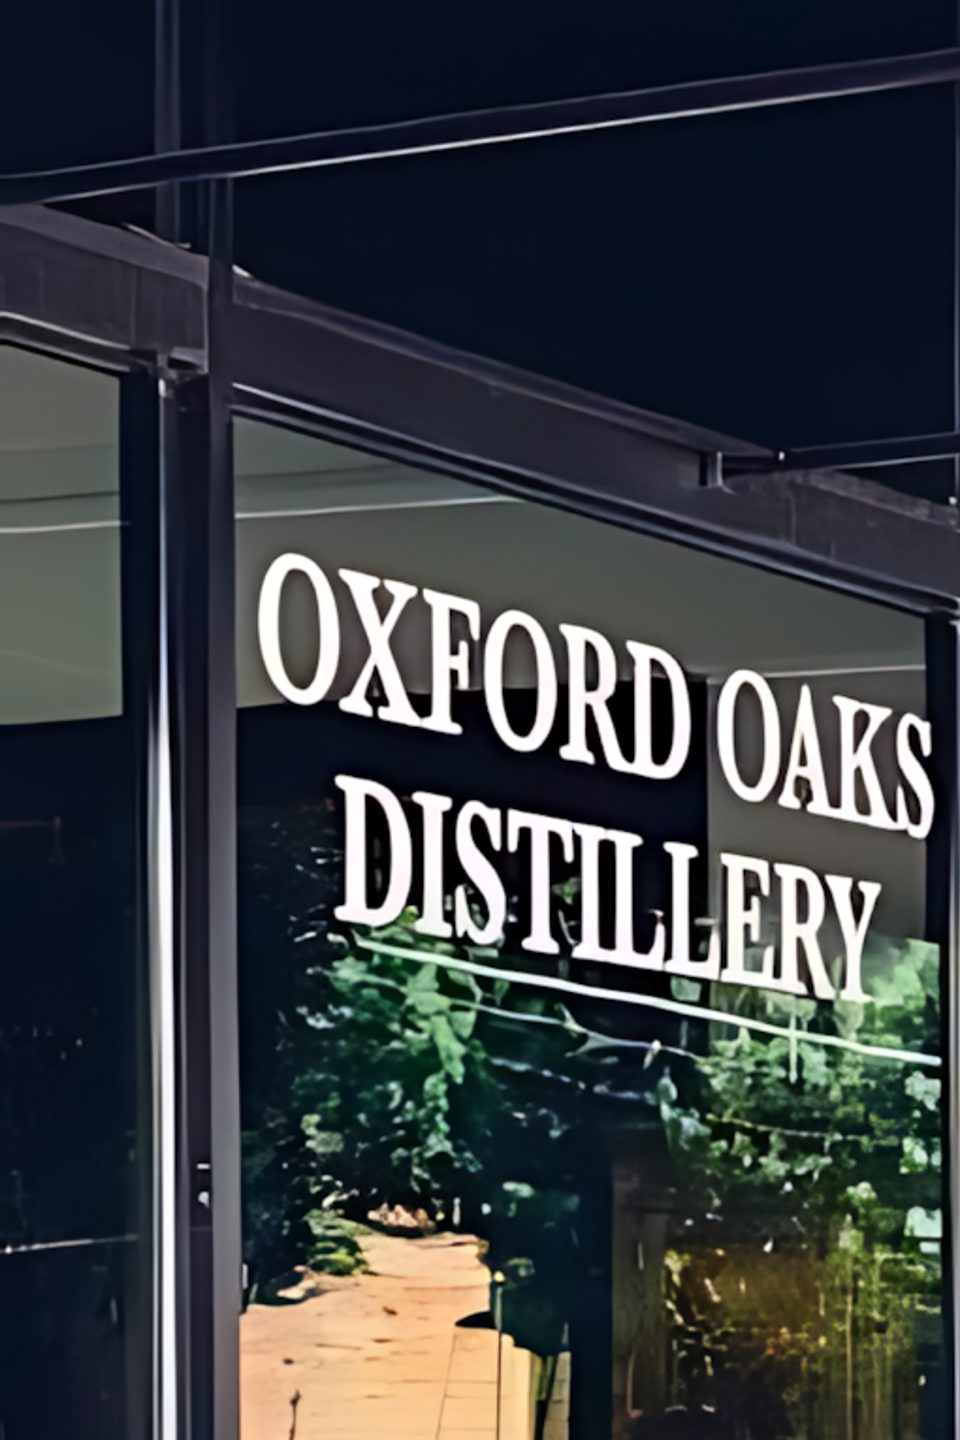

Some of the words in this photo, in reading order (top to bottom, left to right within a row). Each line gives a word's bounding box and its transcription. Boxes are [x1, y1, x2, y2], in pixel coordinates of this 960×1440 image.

[258, 552, 692, 780] OXFORD
[716, 669, 935, 840] OAKS
[333, 774, 882, 1002] DISTILLERY
